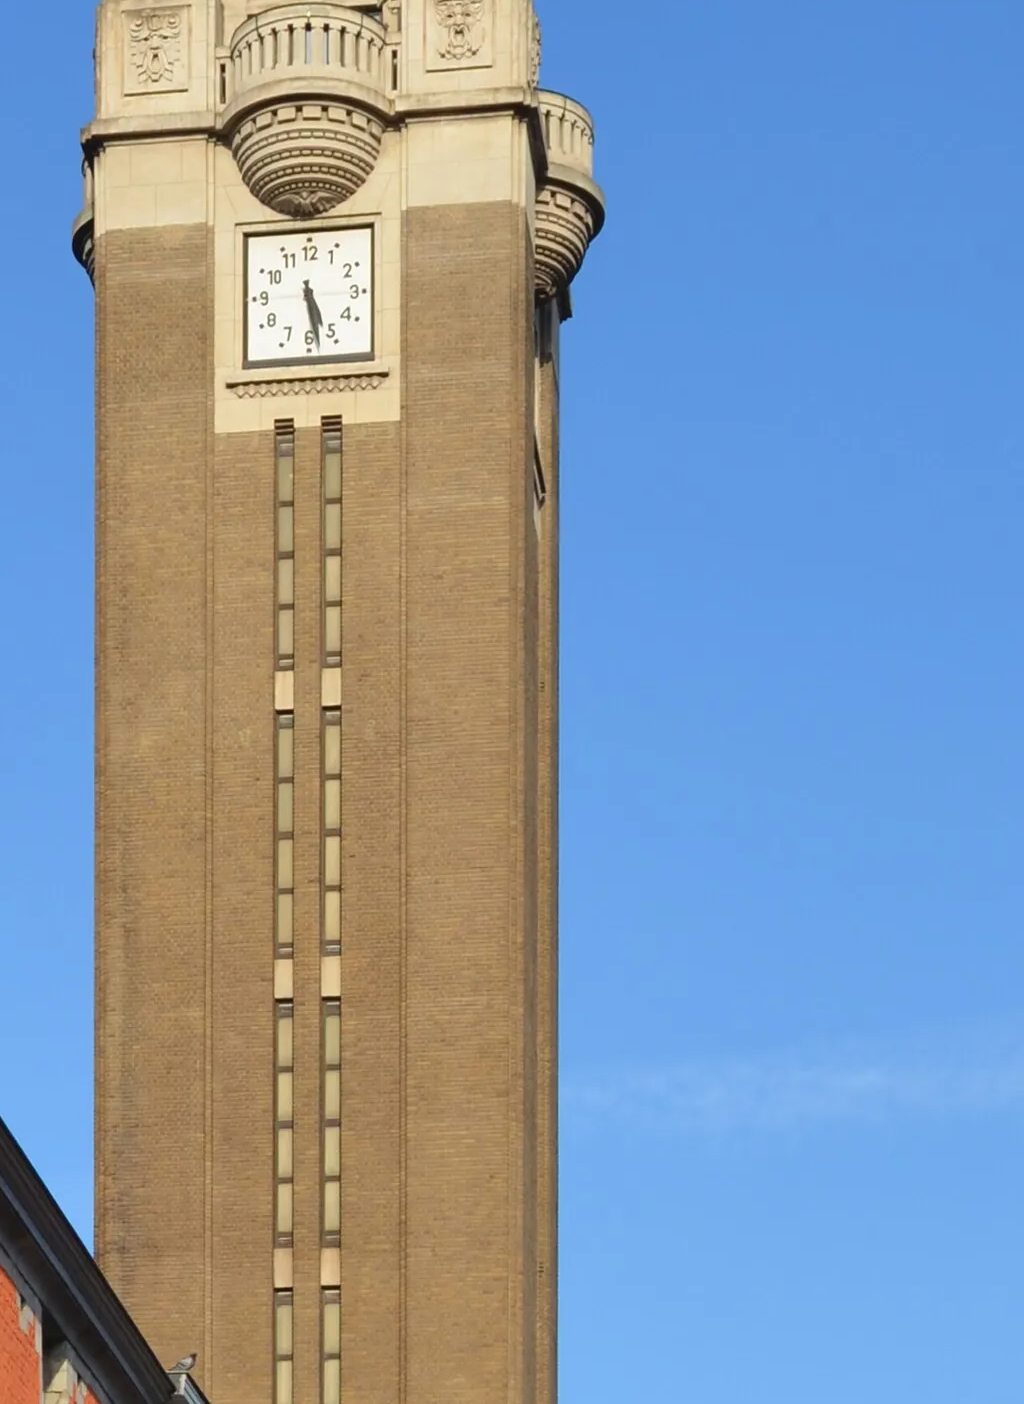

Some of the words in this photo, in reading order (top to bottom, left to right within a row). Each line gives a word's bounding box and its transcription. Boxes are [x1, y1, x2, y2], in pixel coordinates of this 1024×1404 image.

[282, 253, 296, 268] 11
[302, 246, 318, 261] 12
[328, 250, 334, 265] 1
[267, 269, 282, 285] 10
[342, 263, 352, 278] 2
[259, 291, 269, 306] 9
[349, 284, 359, 299] 3
[267, 313, 276, 328] 8
[340, 306, 351, 321] 4
[283, 326, 292, 342] 7
[304, 330, 314, 345] 6
[326, 323, 336, 338] 5
